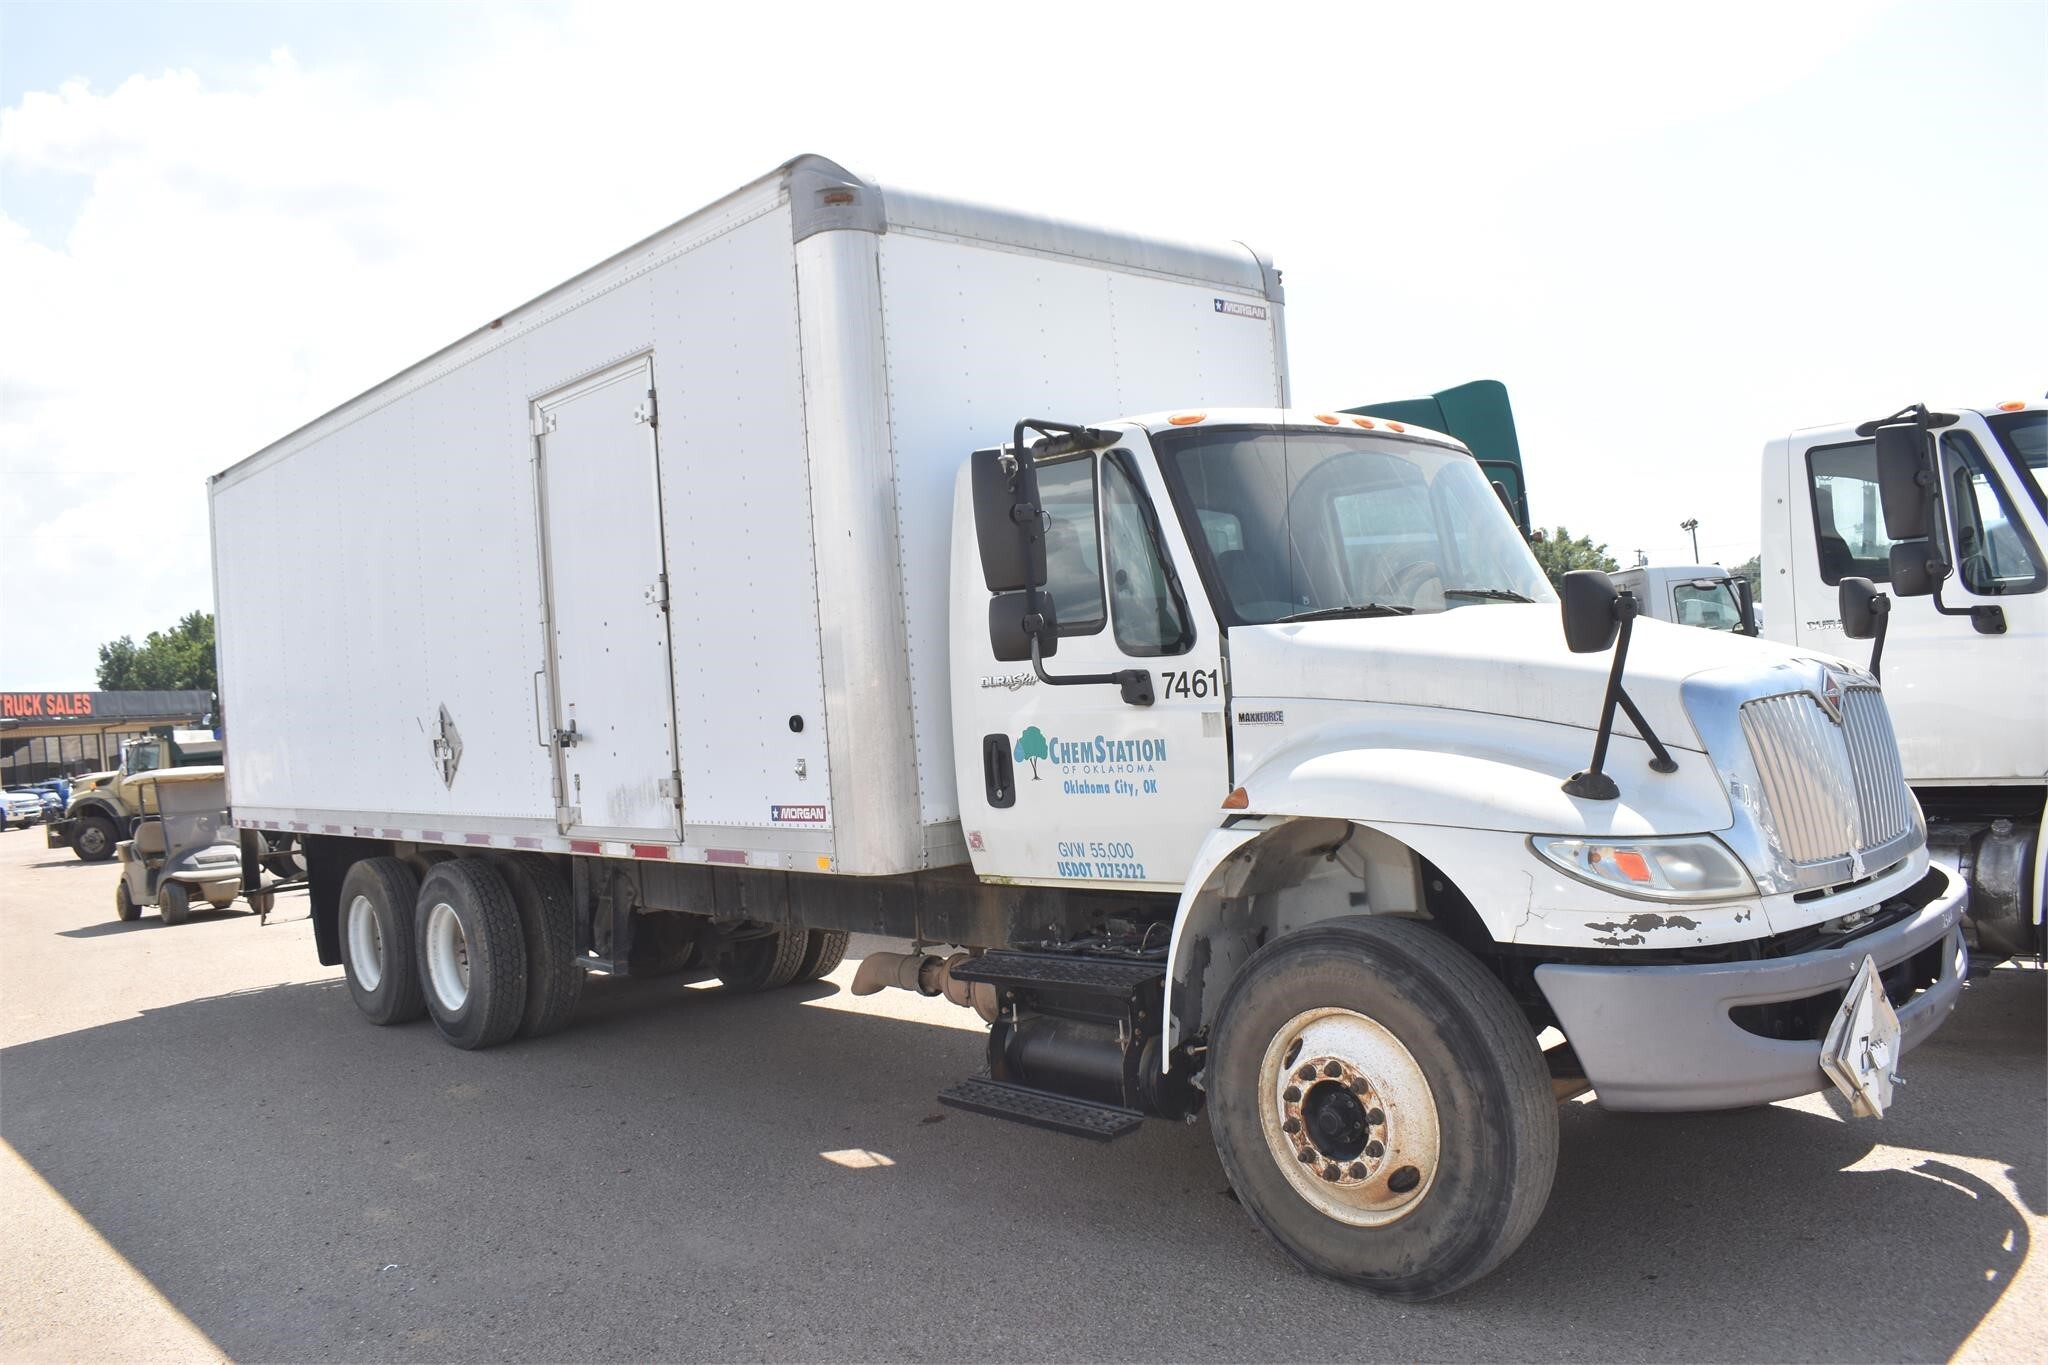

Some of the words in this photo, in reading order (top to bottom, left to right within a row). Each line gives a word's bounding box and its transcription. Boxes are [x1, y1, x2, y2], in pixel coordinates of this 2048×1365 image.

[1222, 302, 1265, 318] MORGAN
[1161, 669, 1218, 699] 7461
[46, 693, 92, 716] SALES
[1238, 710, 1284, 722] MAXXFORCE
[1062, 765, 1077, 774] OF
[1083, 764, 1155, 774] OKLAHOMA
[1063, 779, 1111, 794] Oklahoma
[1114, 779, 1139, 797] City,
[1143, 779, 1158, 794] OK
[780, 807, 825, 820] MORGAN
[1058, 842, 1085, 858] GVW
[1090, 842, 1134, 860] 55,000
[1057, 861, 1093, 878] USDOT
[1095, 862, 1146, 879] 1275222
